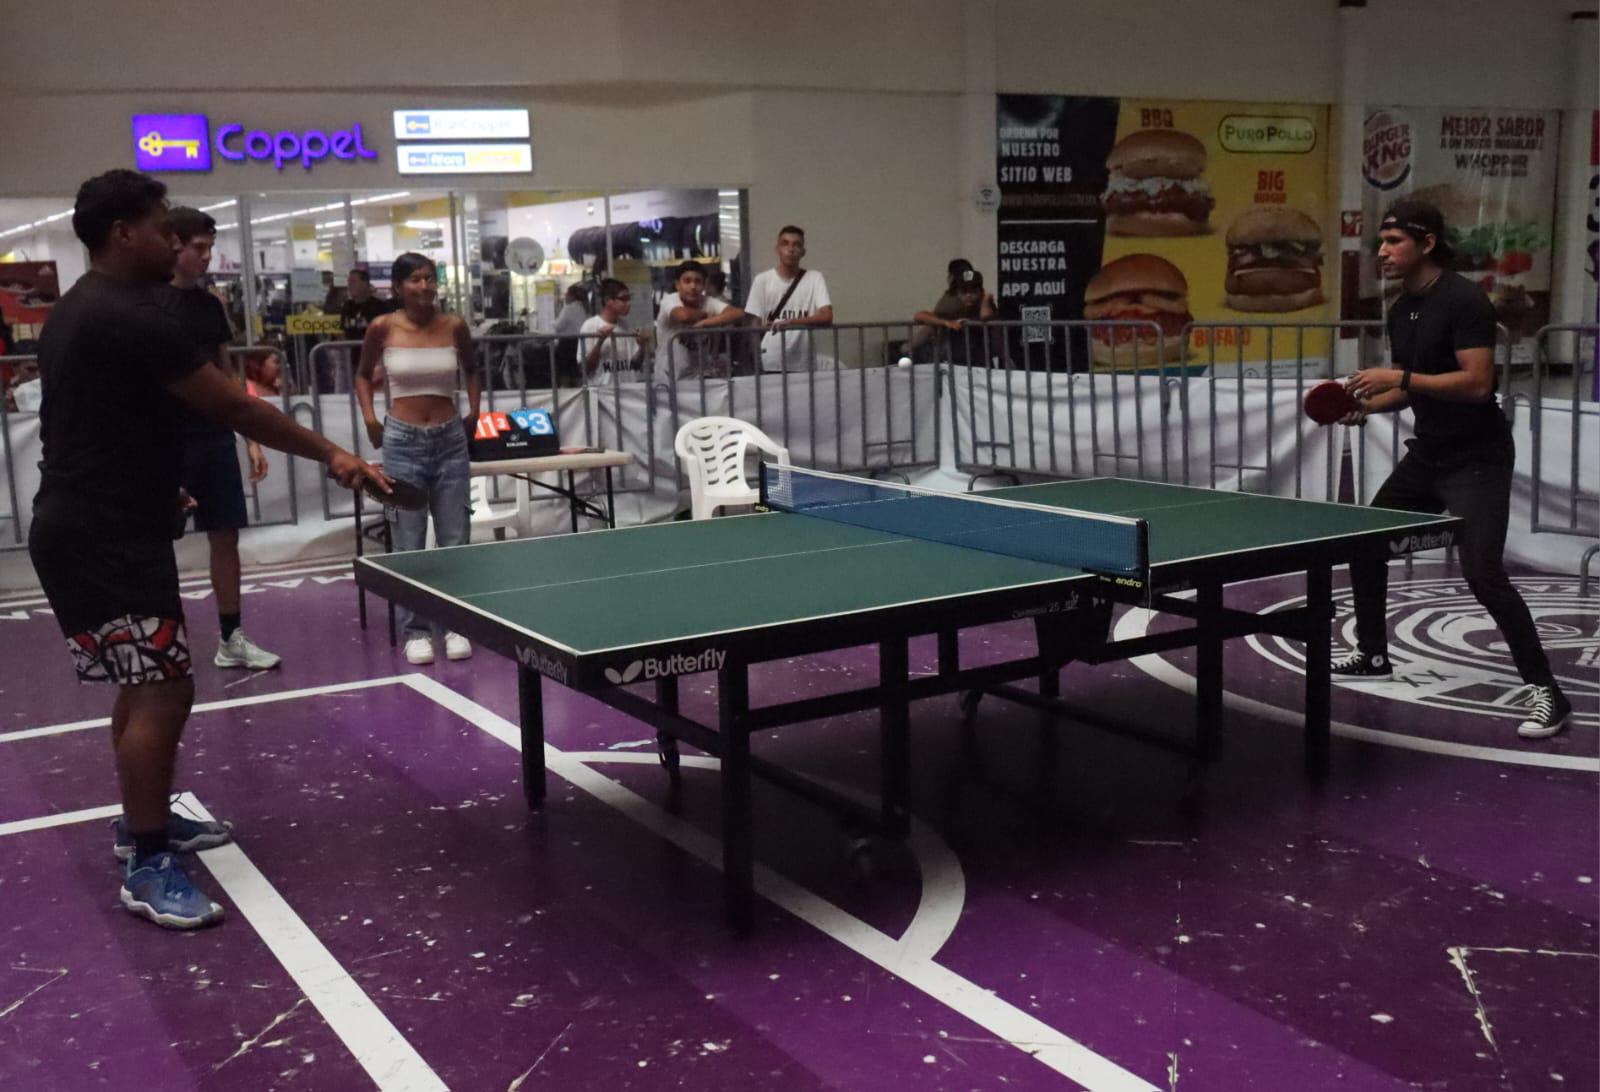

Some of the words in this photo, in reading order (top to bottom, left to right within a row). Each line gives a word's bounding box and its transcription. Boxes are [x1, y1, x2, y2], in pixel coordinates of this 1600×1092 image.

[1140, 109, 1174, 129] BBQ
[1496, 116, 1546, 137] SABOR
[215, 122, 378, 170] Coppel
[1001, 142, 1061, 158] NUESTRO
[1000, 166, 1037, 183] SITIO
[1042, 166, 1073, 183] WEB
[1256, 170, 1285, 191] BIG
[1000, 240, 1066, 255] DESCARGA
[1001, 256, 1067, 272] NUESTRA
[1002, 282, 1031, 297] APP
[292, 318, 343, 333] Coppe
[496, 417, 506, 429] 3
[529, 412, 551, 434] 3
[1115, 576, 1143, 588] andro
[642, 647, 728, 679] Butterfly
